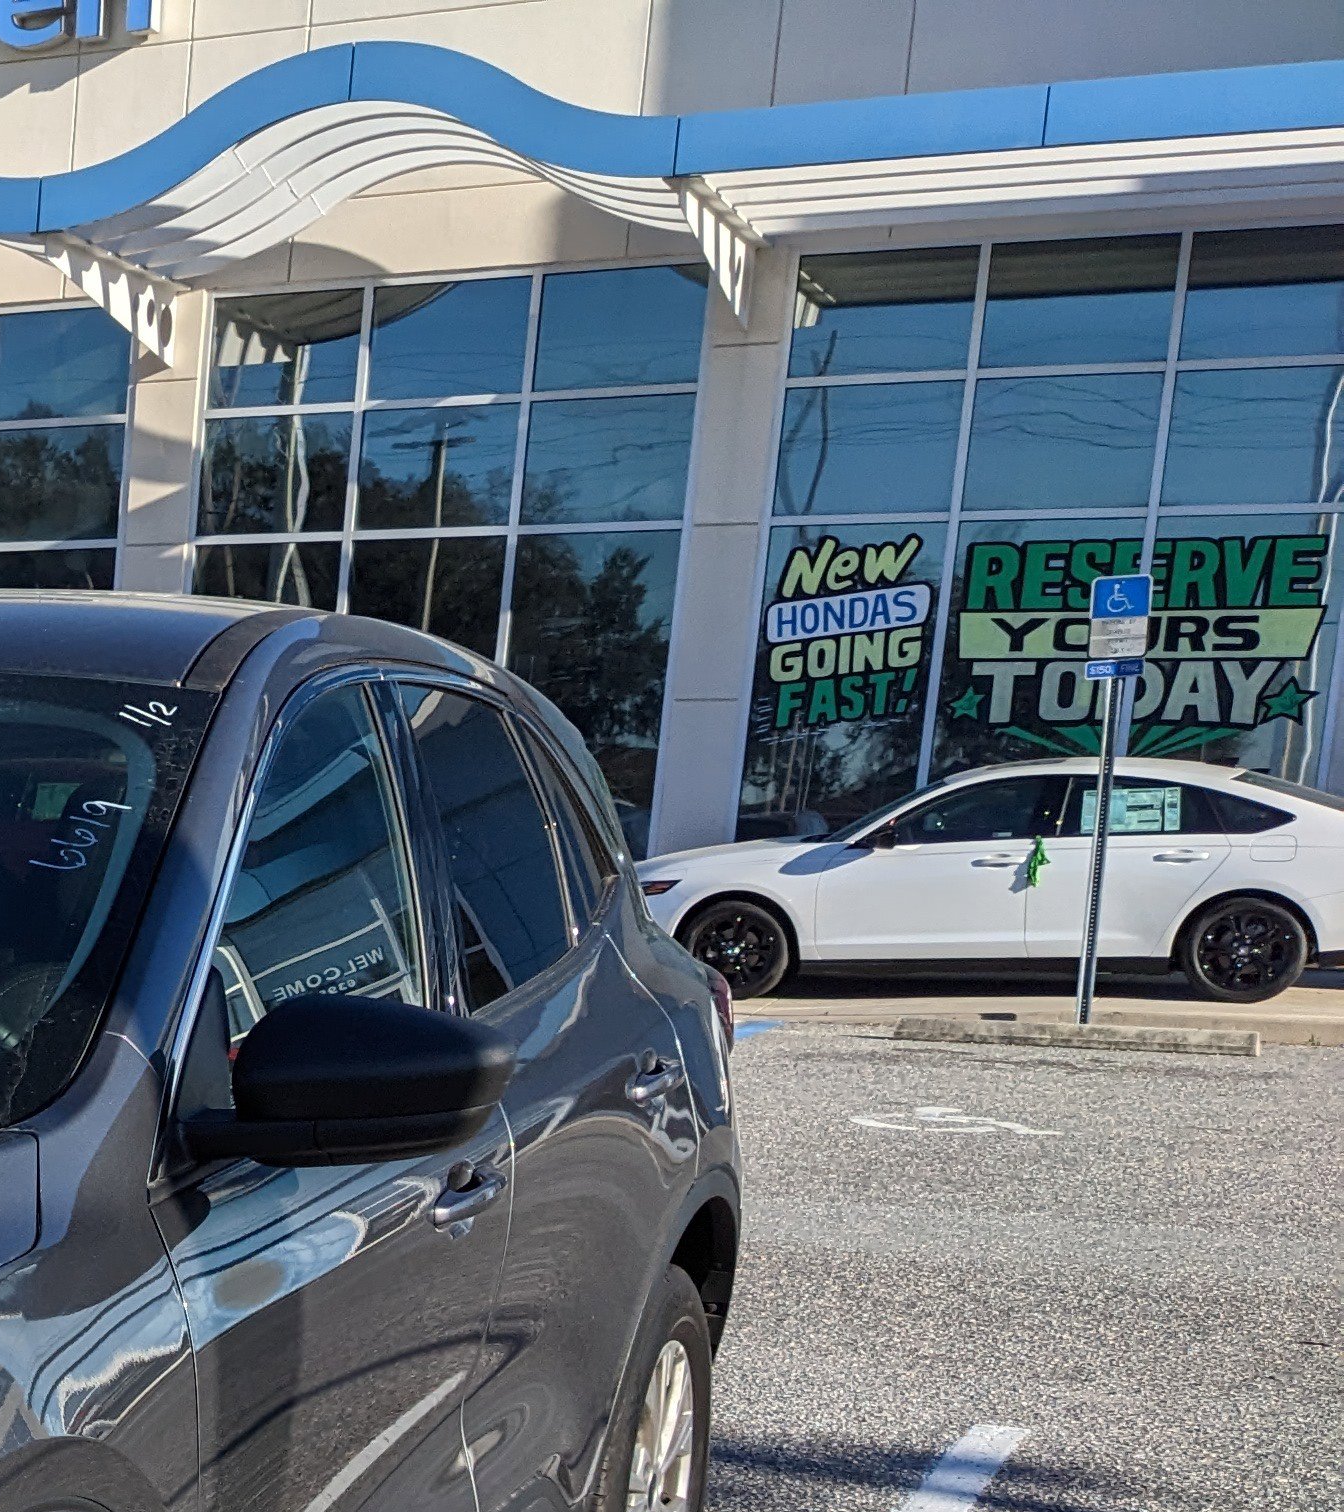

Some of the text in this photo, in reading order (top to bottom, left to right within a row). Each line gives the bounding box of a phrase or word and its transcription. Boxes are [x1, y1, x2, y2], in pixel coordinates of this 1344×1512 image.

[781, 537, 920, 598] New
[966, 536, 1327, 610] RESERVE
[777, 590, 918, 638] HONDAS
[770, 626, 922, 683] GOING
[775, 668, 917, 728] FAST!
[971, 660, 1284, 725] TODAY
